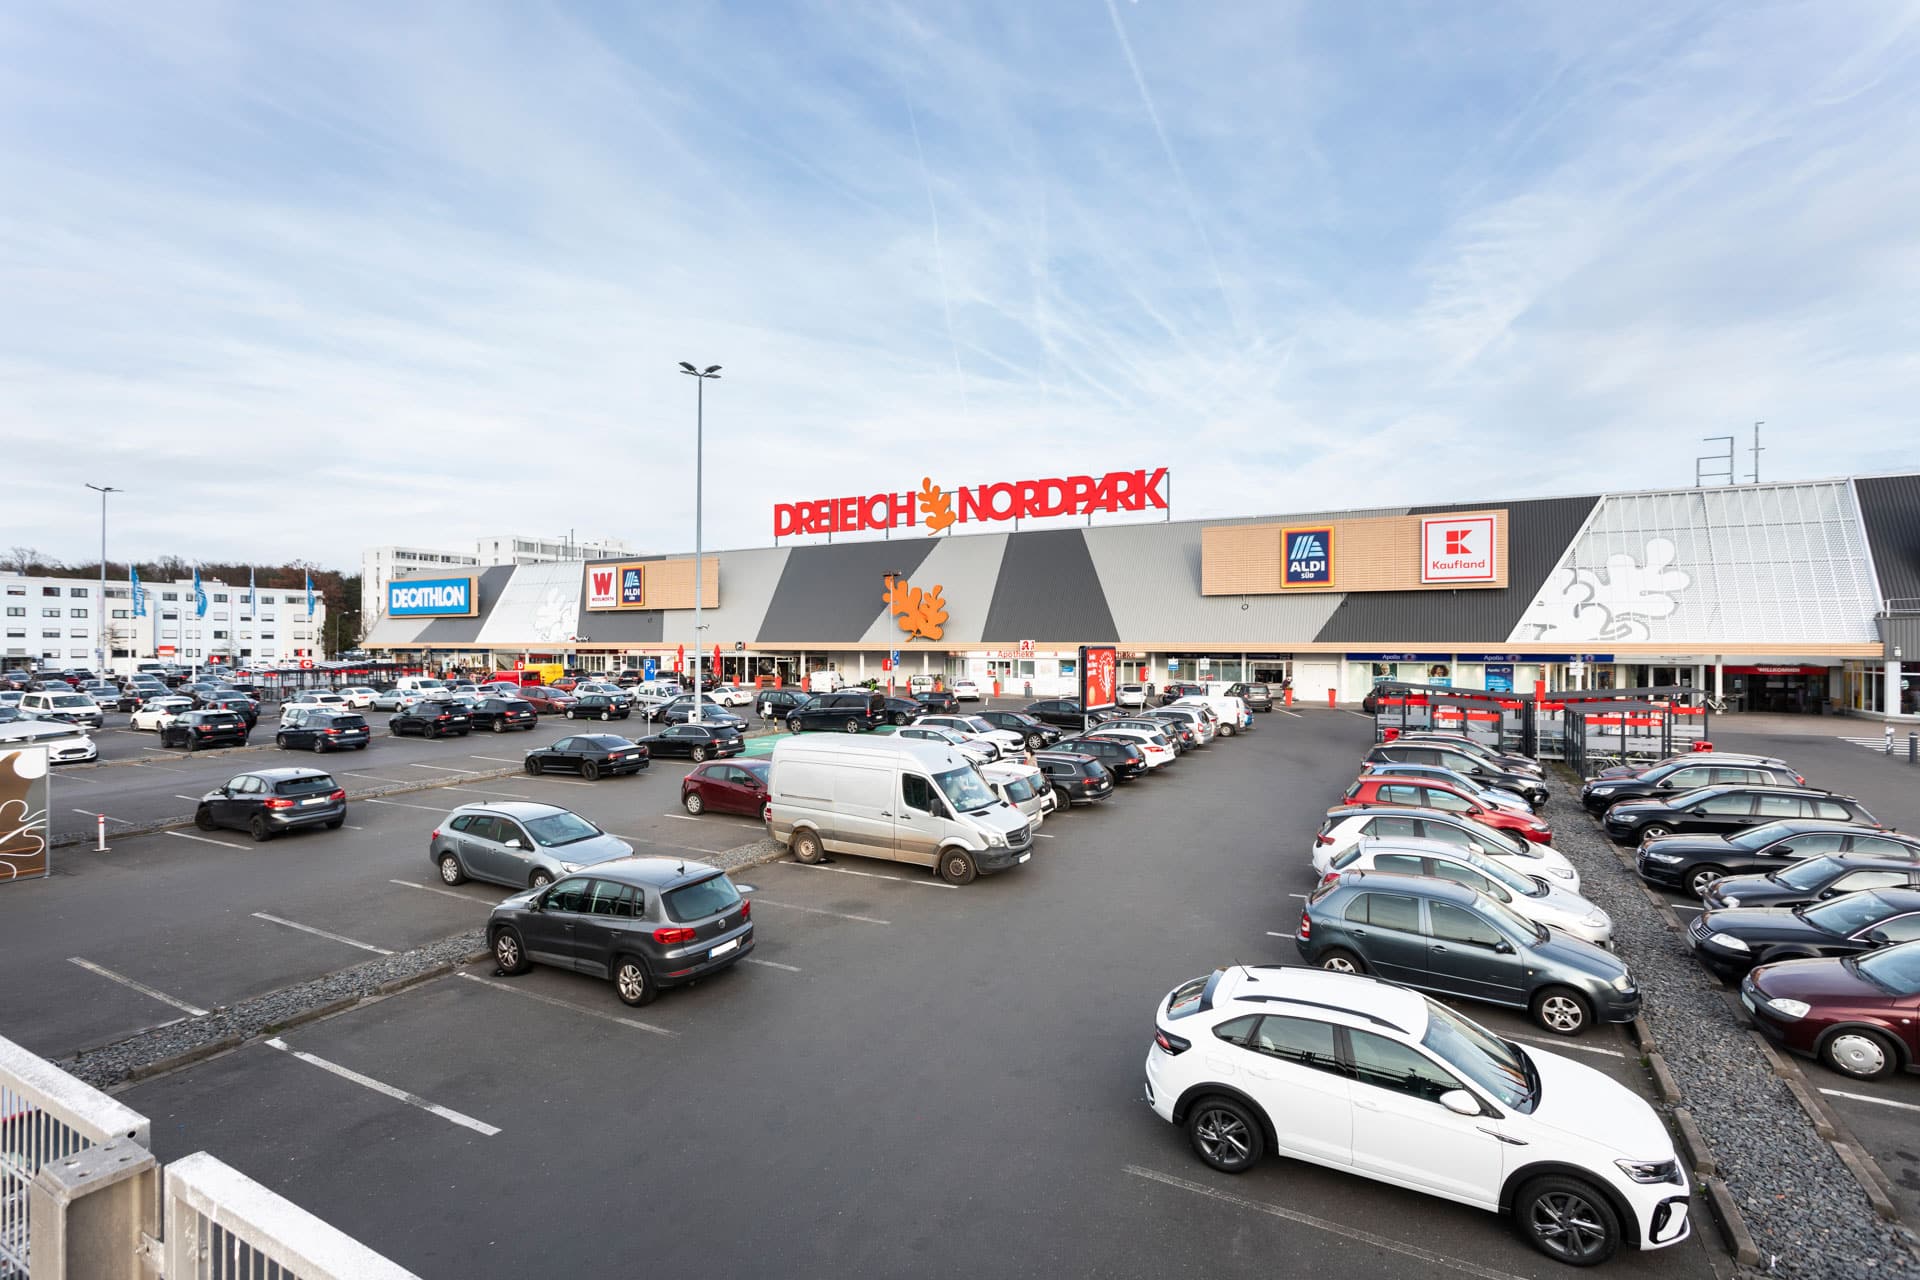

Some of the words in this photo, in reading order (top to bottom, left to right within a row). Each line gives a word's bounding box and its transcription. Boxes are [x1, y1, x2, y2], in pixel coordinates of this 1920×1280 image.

[774, 491, 916, 537] DREIEICH
[958, 467, 1169, 523] NORDPARK
[1290, 560, 1326, 573] ALDI
[1432, 559, 1486, 570] Kaufland
[593, 572, 612, 595] W
[392, 585, 465, 609] DECATHLON
[624, 588, 641, 596] ALDI
[997, 650, 1035, 659] Apotheke
[517, 661, 524, 669] D
[645, 661, 651, 670] P
